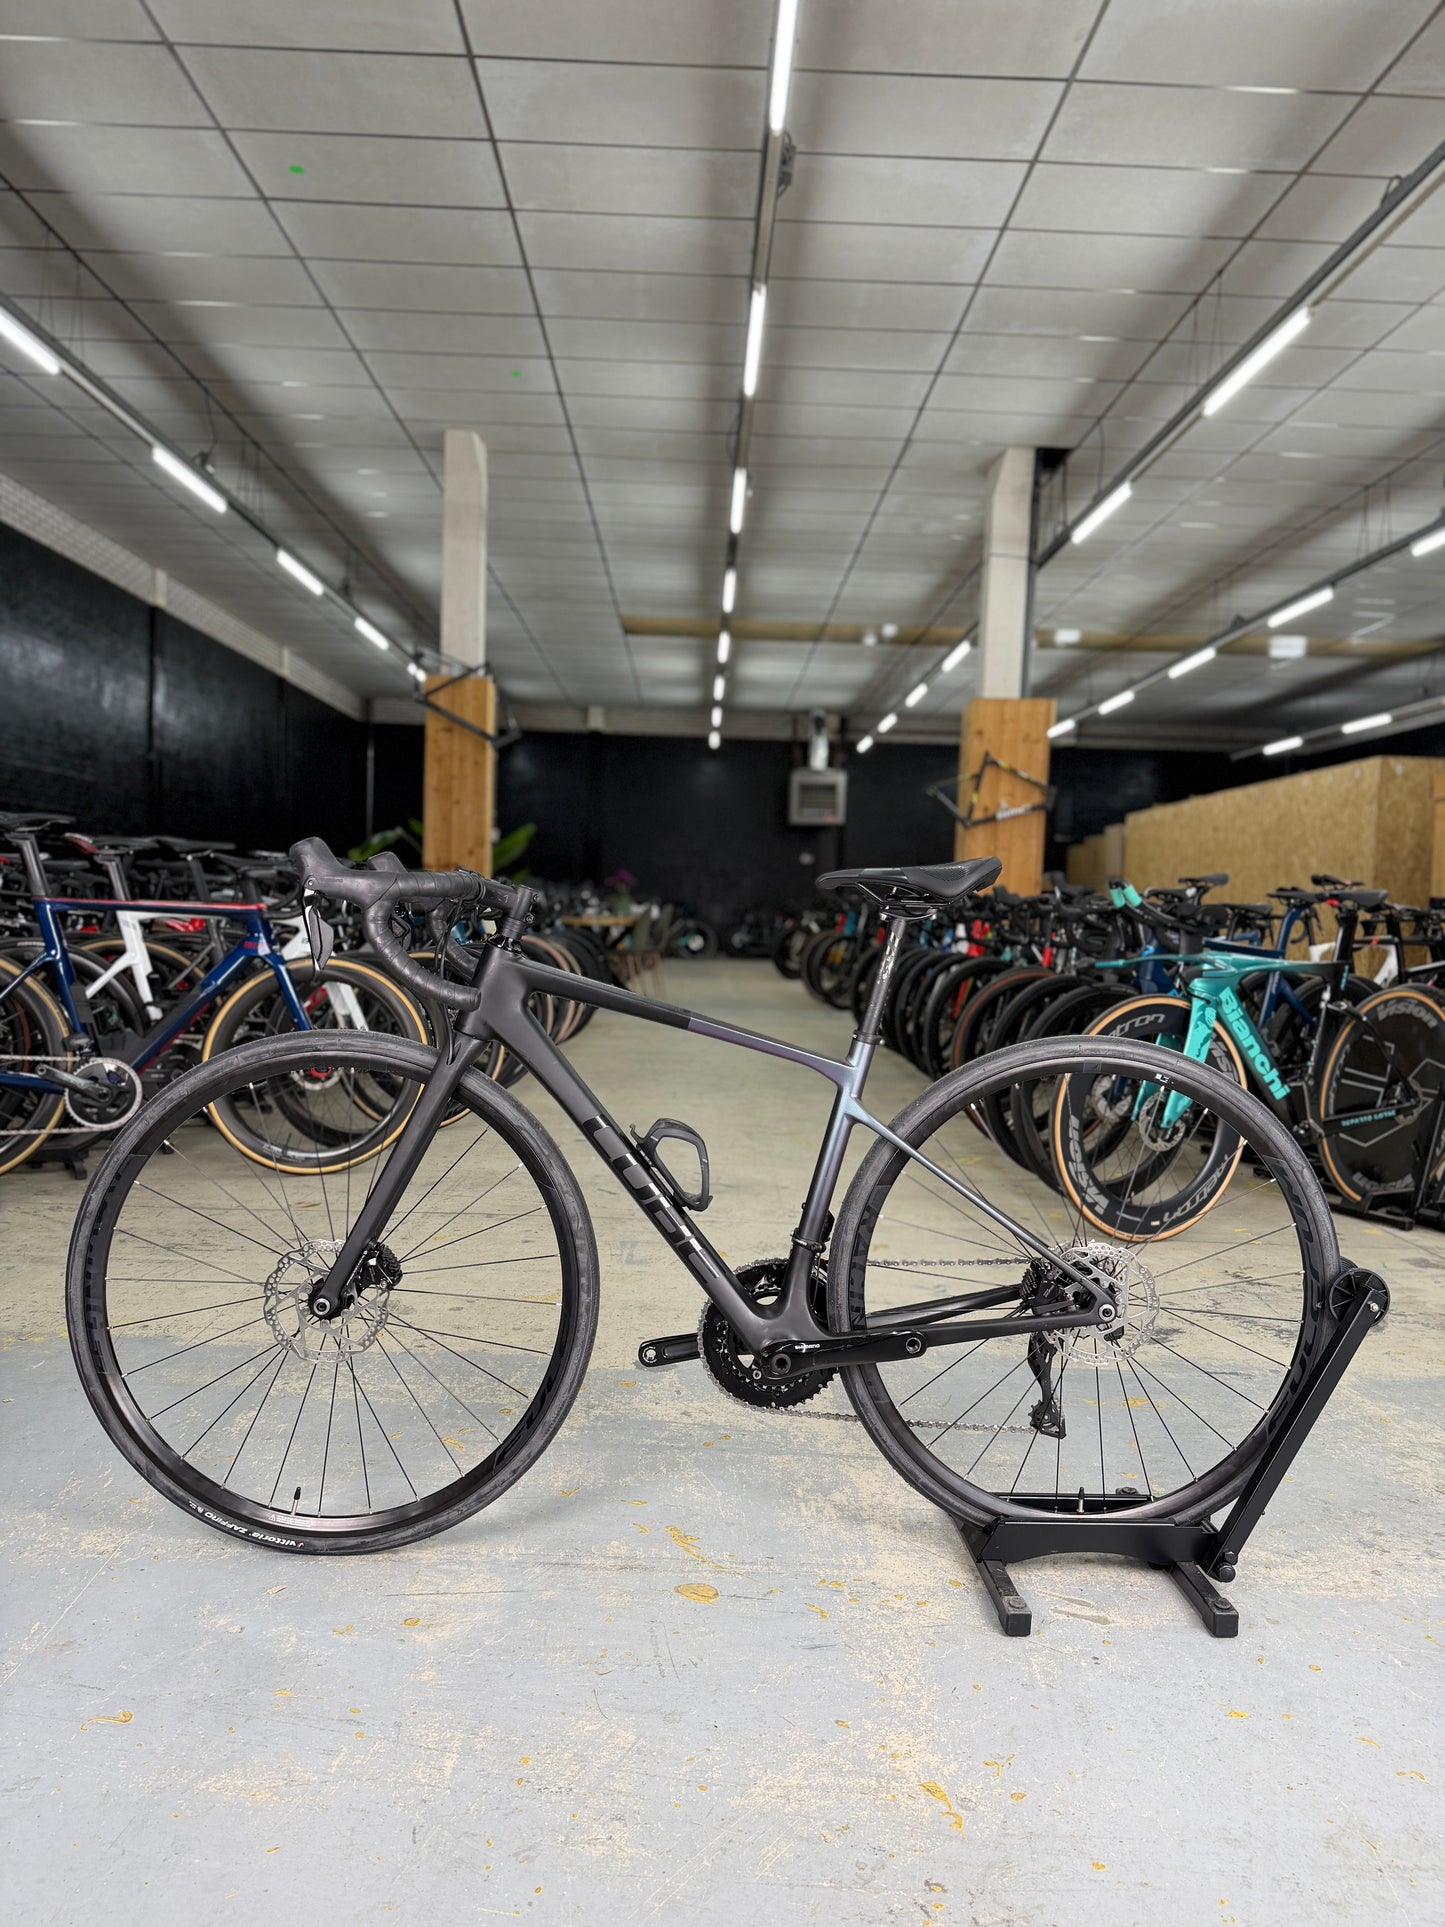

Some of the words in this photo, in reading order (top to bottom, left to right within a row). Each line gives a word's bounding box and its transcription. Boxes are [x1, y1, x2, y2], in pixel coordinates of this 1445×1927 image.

[1218, 986, 1291, 1100] Bianchi
[582, 1114, 720, 1284] CUBE
[204, 1511, 248, 1534] ZAFFIRO
